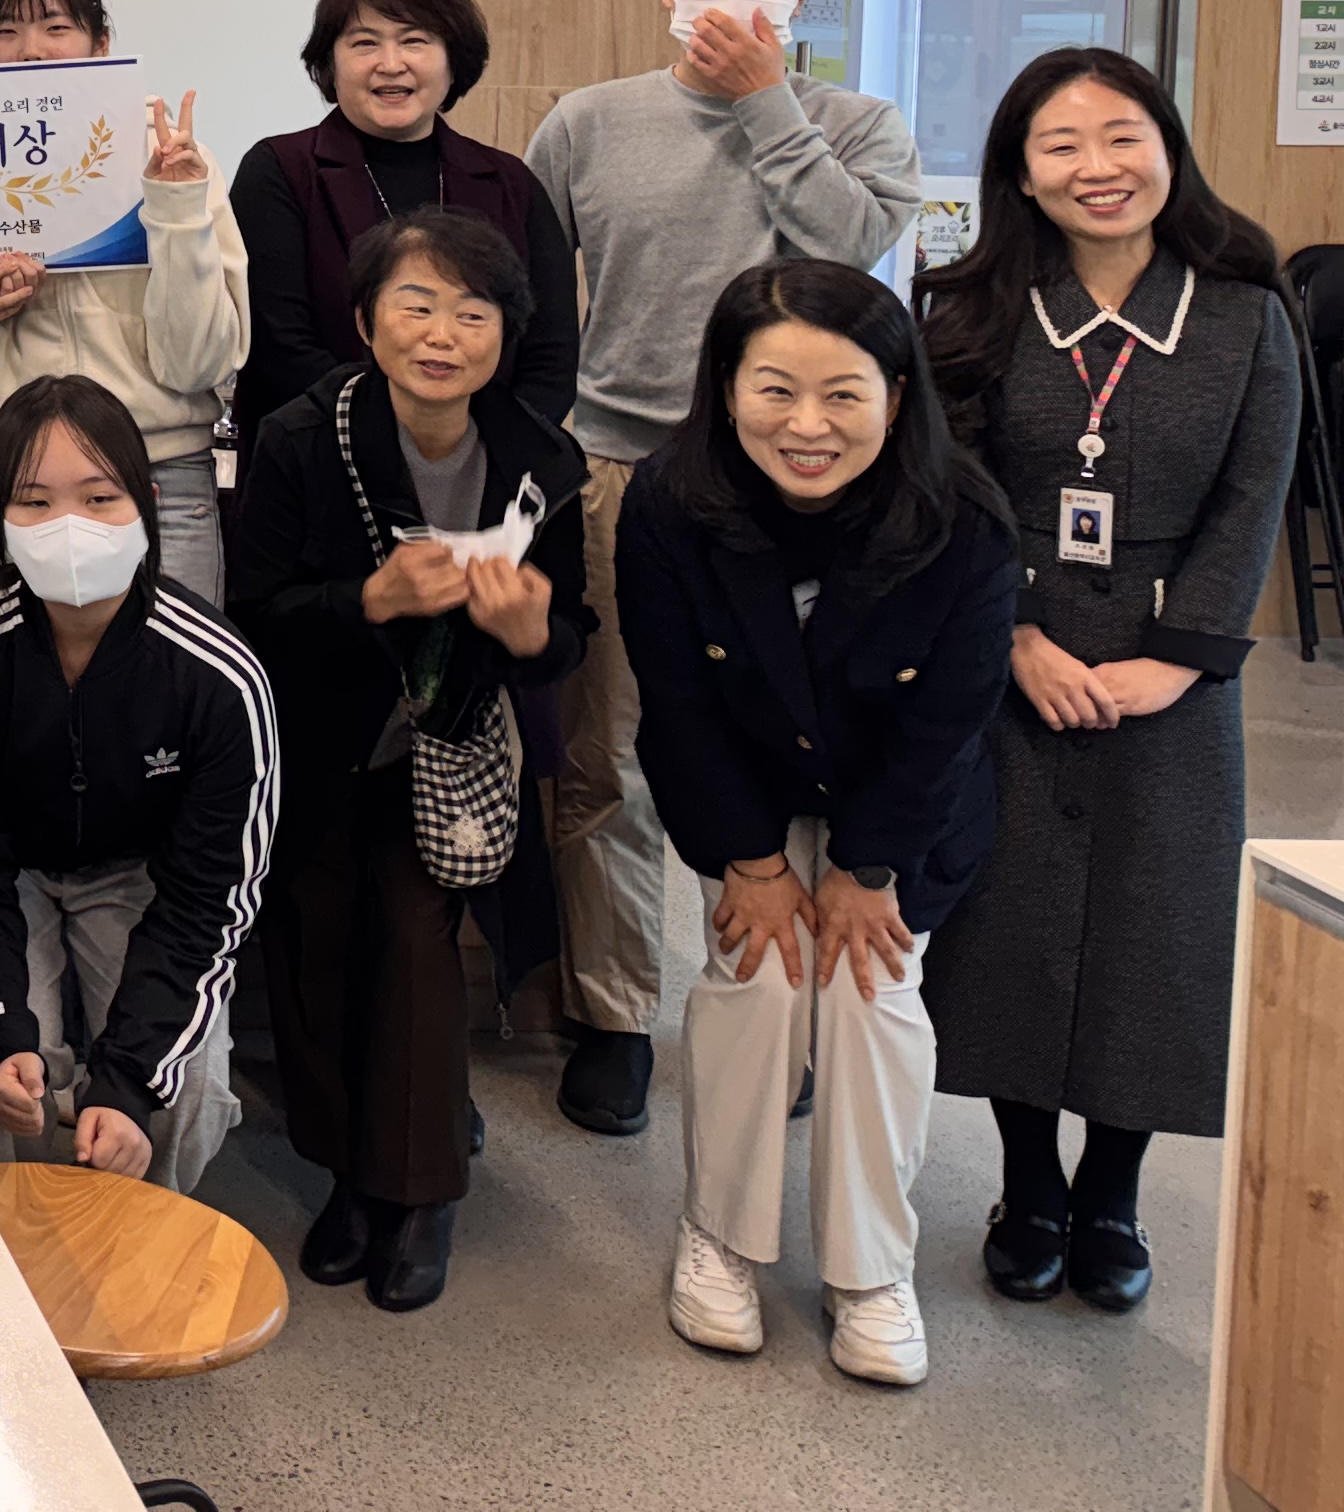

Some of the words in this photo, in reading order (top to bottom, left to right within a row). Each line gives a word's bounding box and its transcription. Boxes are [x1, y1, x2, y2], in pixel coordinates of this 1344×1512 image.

[1314, 41, 1336, 50] 2교시
[1313, 77, 1334, 86] 3교시
[1, 97, 30, 113] 요리
[35, 95, 64, 112] 경연
